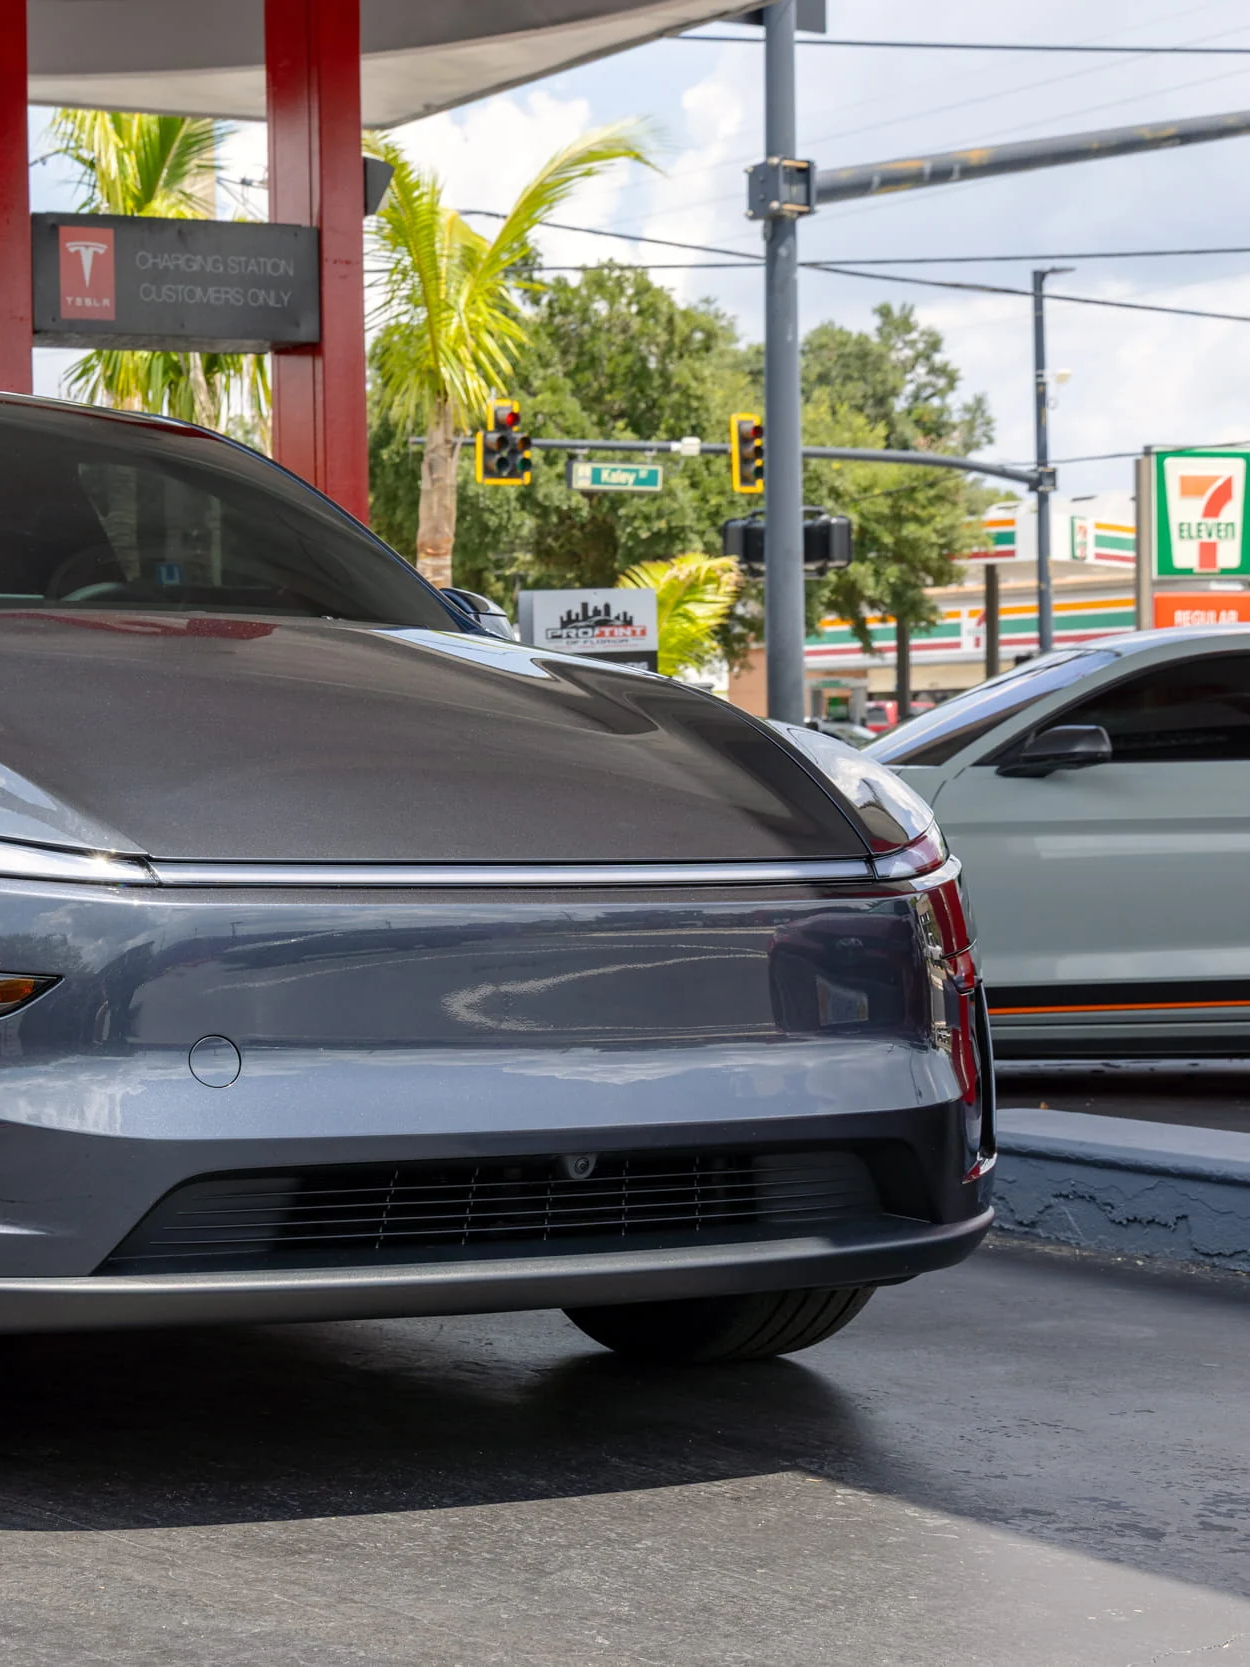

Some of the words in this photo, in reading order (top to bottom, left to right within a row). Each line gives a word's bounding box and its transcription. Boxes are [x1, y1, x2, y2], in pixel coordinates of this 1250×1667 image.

[136, 251, 224, 273] CHARGING
[227, 256, 295, 277] STATION
[66, 296, 111, 308] TESLA
[139, 283, 245, 306] CUSTOMERS
[247, 288, 293, 308] ONLY
[1173, 609, 1239, 628] REGULAR
